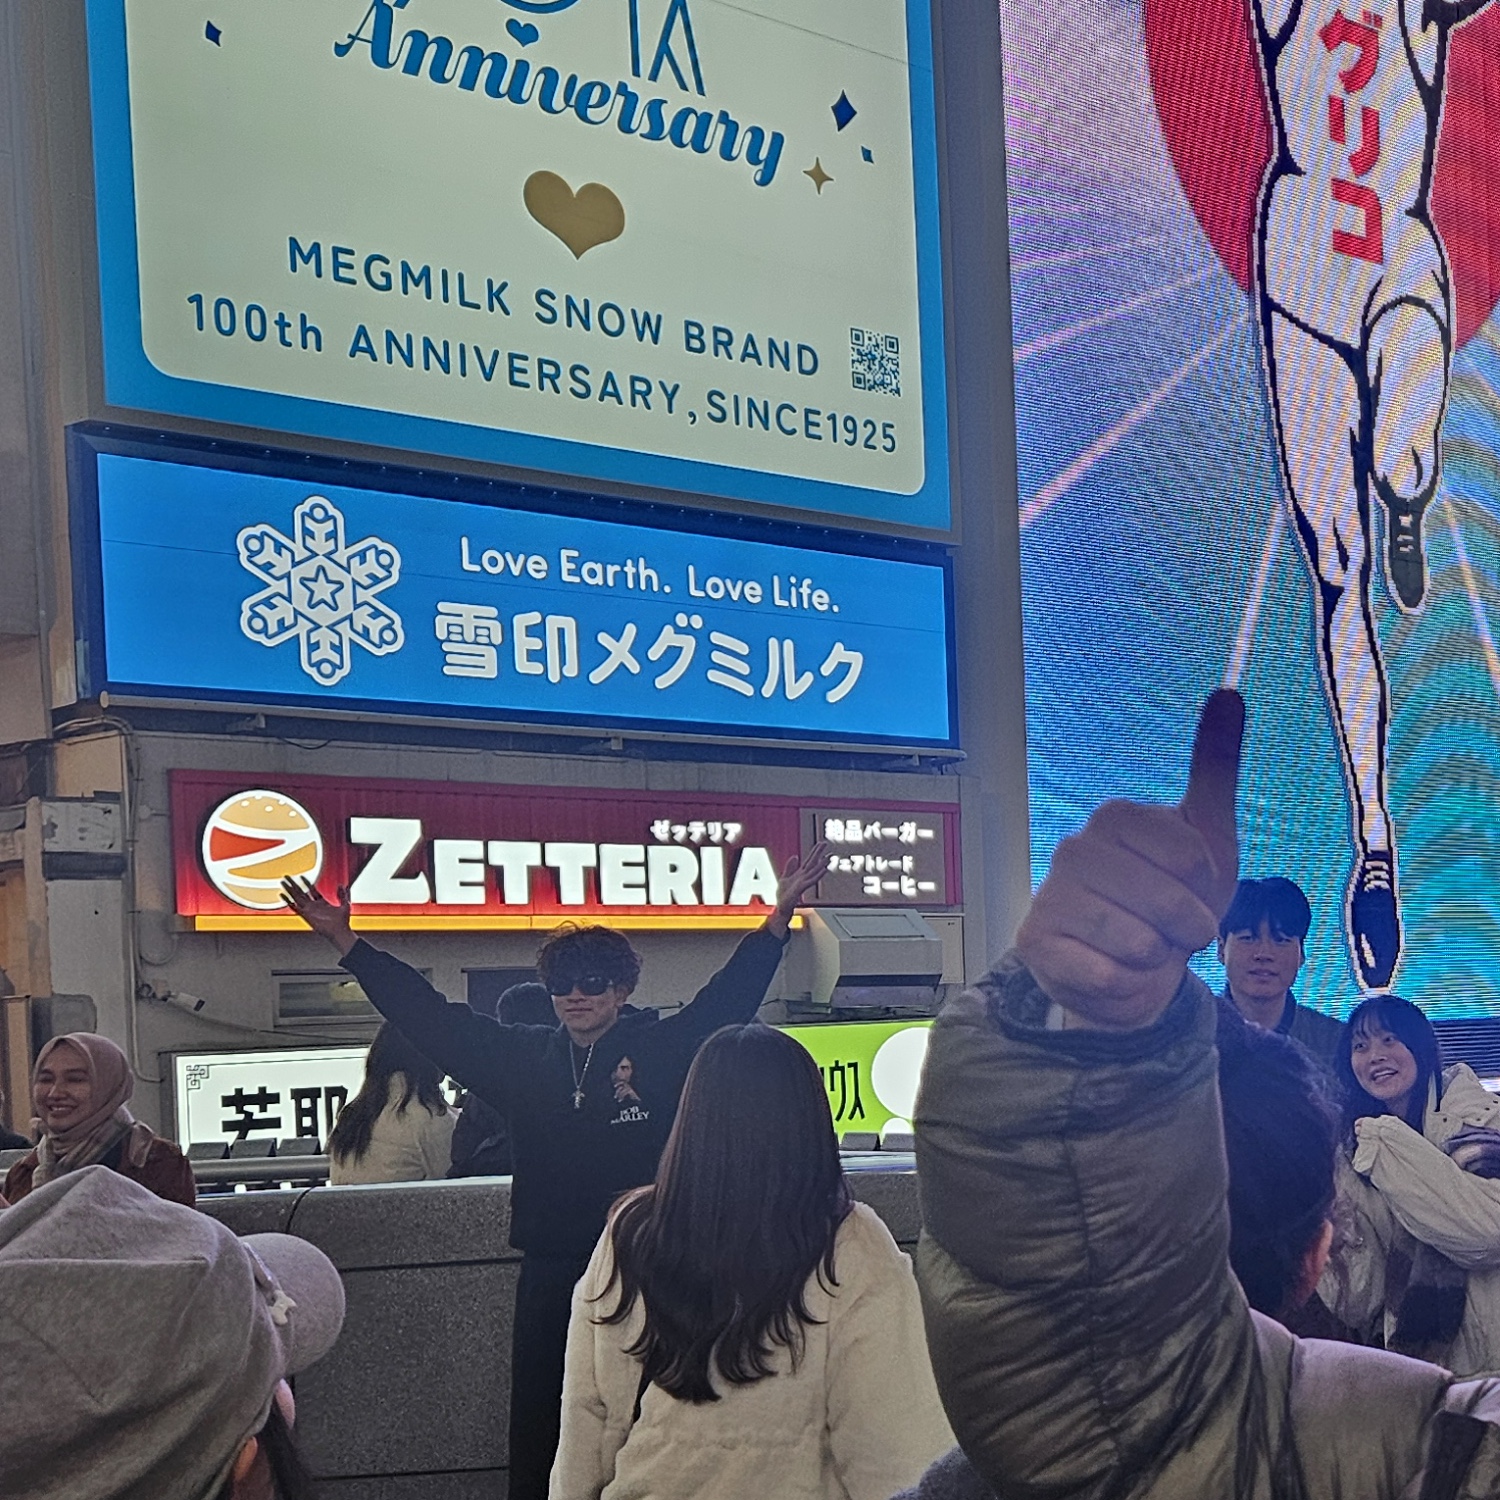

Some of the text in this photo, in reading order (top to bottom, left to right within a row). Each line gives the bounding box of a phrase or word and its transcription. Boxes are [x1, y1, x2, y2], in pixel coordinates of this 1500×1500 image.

[334, 0, 785, 187] Anniversary
[1318, 9, 1384, 264] グリコ
[187, 293, 323, 353] 100th
[288, 235, 820, 378] MEGMILK SNOW BRAND
[460, 537, 841, 615] Love Earth. Love Life.
[433, 600, 867, 705] 雪印メグミルク
[349, 816, 779, 907] ZETTERIA
[650, 819, 743, 844] ゼッテリア
[824, 818, 935, 845] 絶品バーガー
[827, 854, 915, 875] フェアトレード
[862, 874, 937, 898] コーヒー
[620, 1106, 639, 1114] BOB
